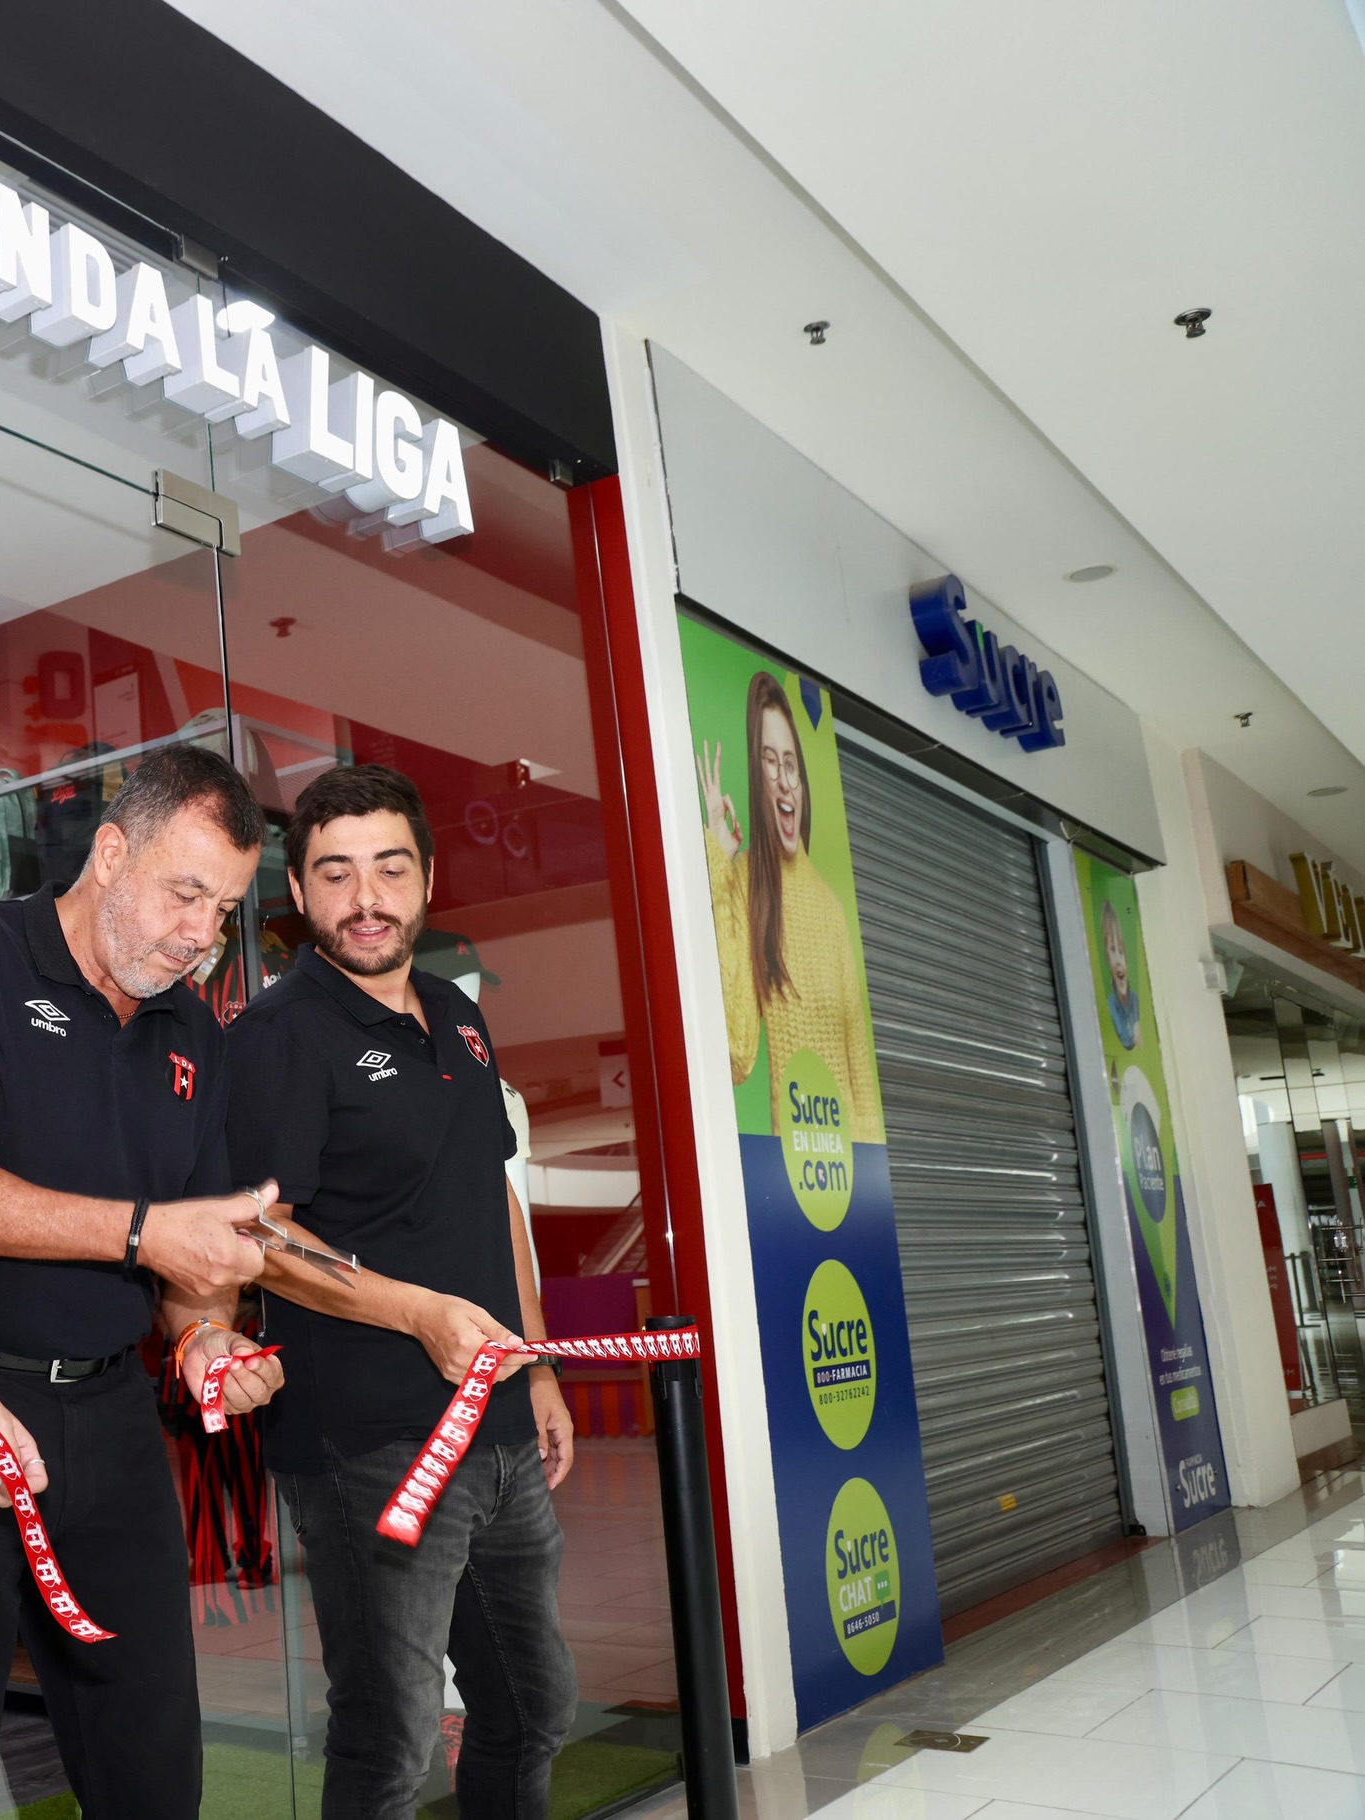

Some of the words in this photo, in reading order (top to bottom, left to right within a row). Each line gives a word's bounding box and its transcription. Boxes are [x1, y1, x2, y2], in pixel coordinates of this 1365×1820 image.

[187, 294, 290, 432] LA
[300, 345, 474, 536] LIGA
[918, 574, 1066, 752] Sucre
[31, 1017, 67, 1038] umbro
[174, 1055, 194, 1071] LDA
[368, 1067, 398, 1082] umbro
[788, 1081, 840, 1127] Sucre
[792, 1130, 810, 1152] EN
[810, 1124, 844, 1154] LÍNEA
[1133, 1135, 1162, 1171] Plan
[798, 1159, 848, 1191] .com
[808, 1309, 868, 1362] Sucre
[816, 1364, 868, 1384] 800-FARMACIA
[818, 1385, 870, 1406] 800-32762242
[1178, 1459, 1217, 1509] Sucre
[834, 1529, 890, 1580] Sucre
[839, 1576, 873, 1612] CHAT
[847, 1611, 880, 1635] 8646-5050
